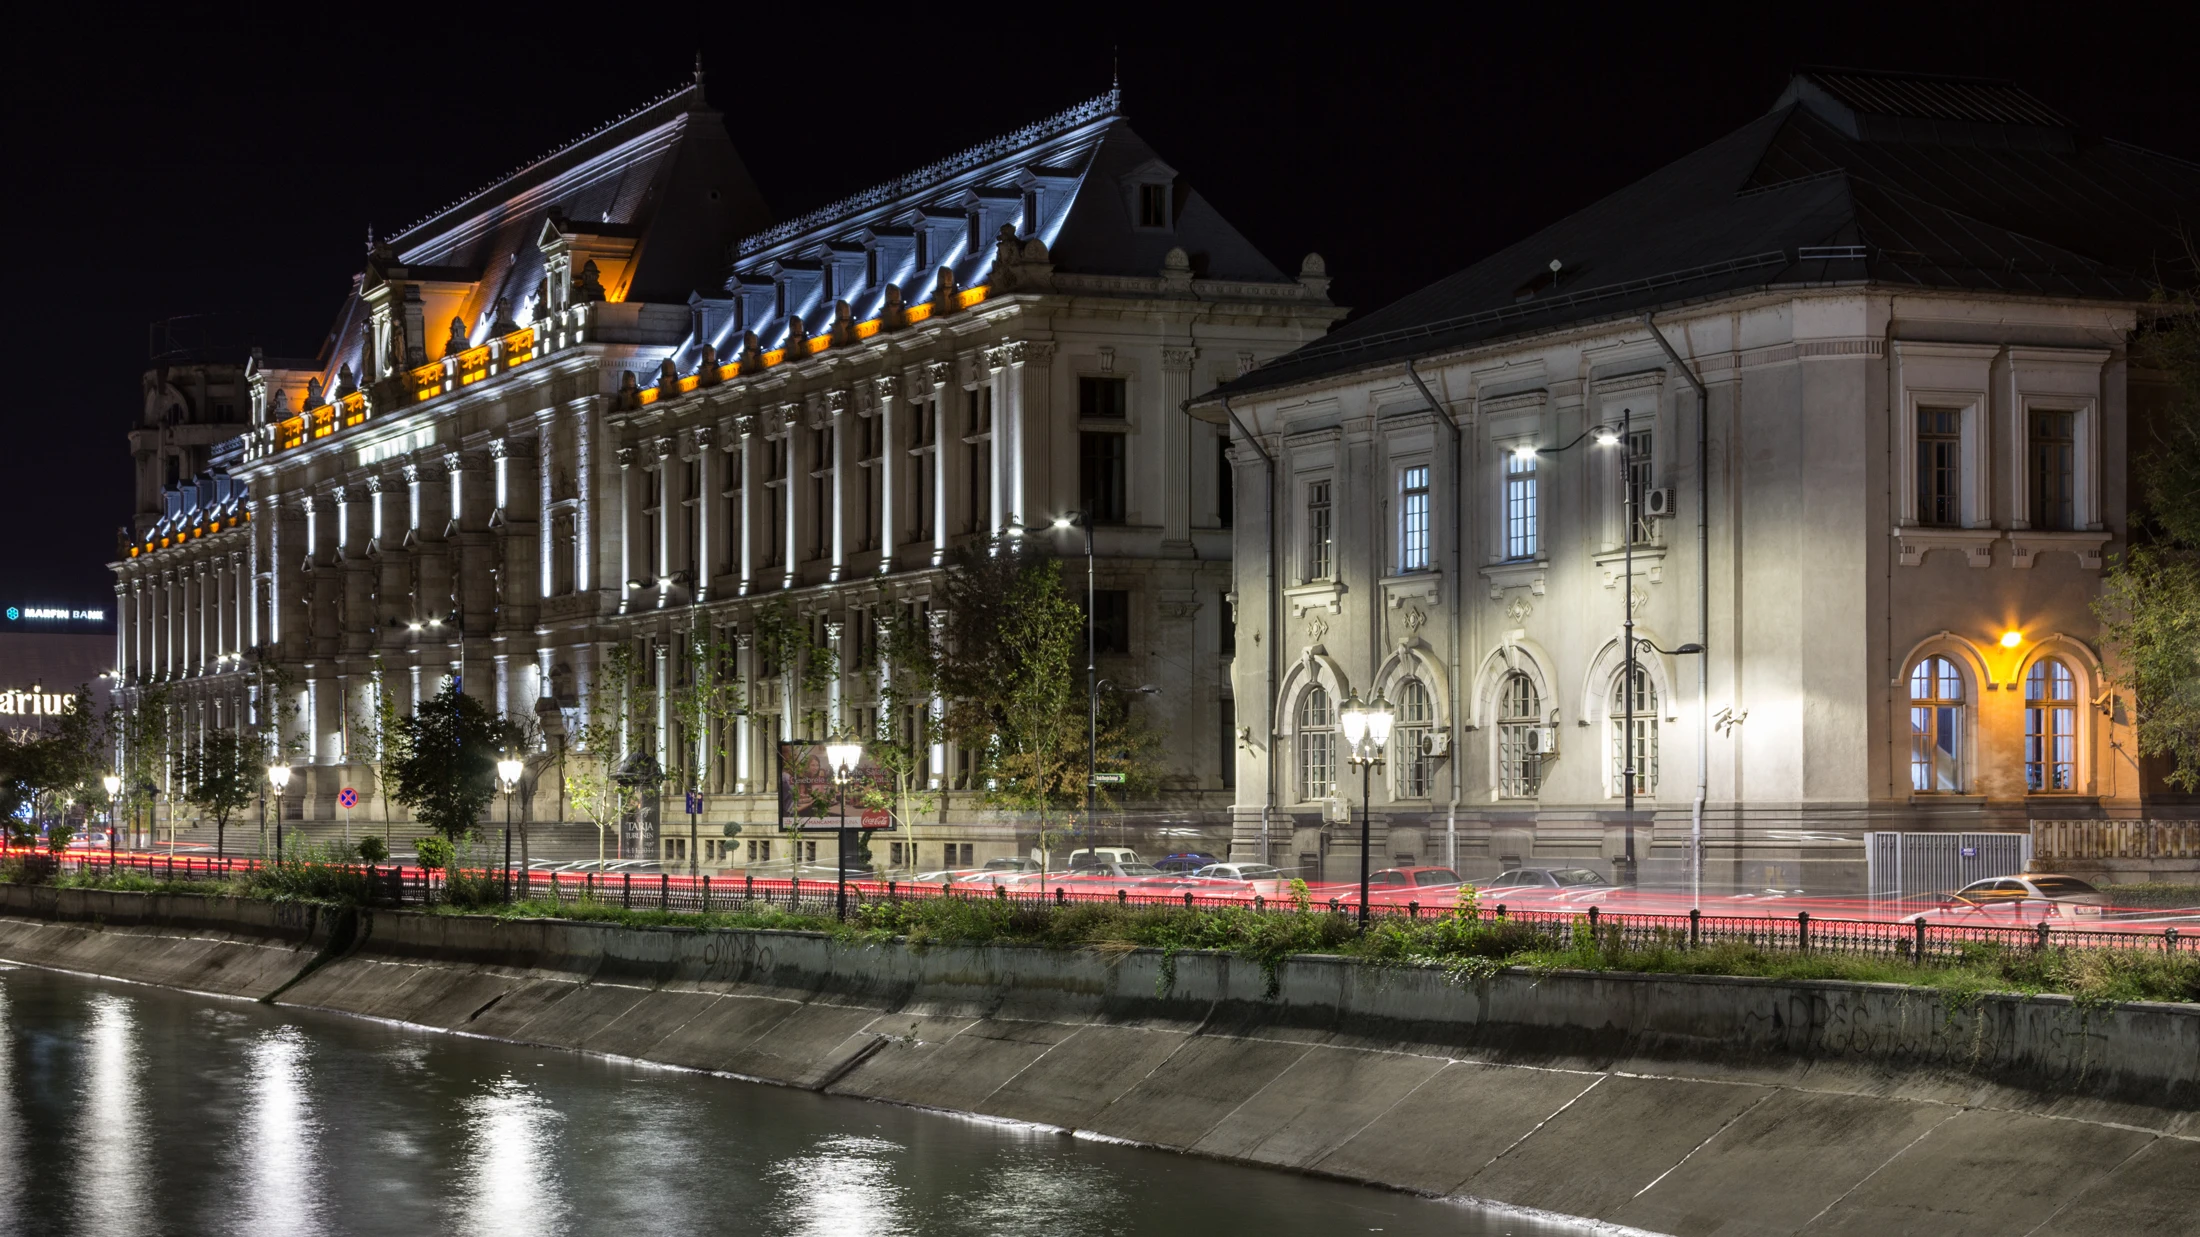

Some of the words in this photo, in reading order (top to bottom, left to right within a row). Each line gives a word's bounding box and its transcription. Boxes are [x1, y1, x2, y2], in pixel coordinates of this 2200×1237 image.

[25, 608, 69, 619] MARFIN
[72, 609, 103, 619] BANK
[627, 822, 654, 832] TARJA
